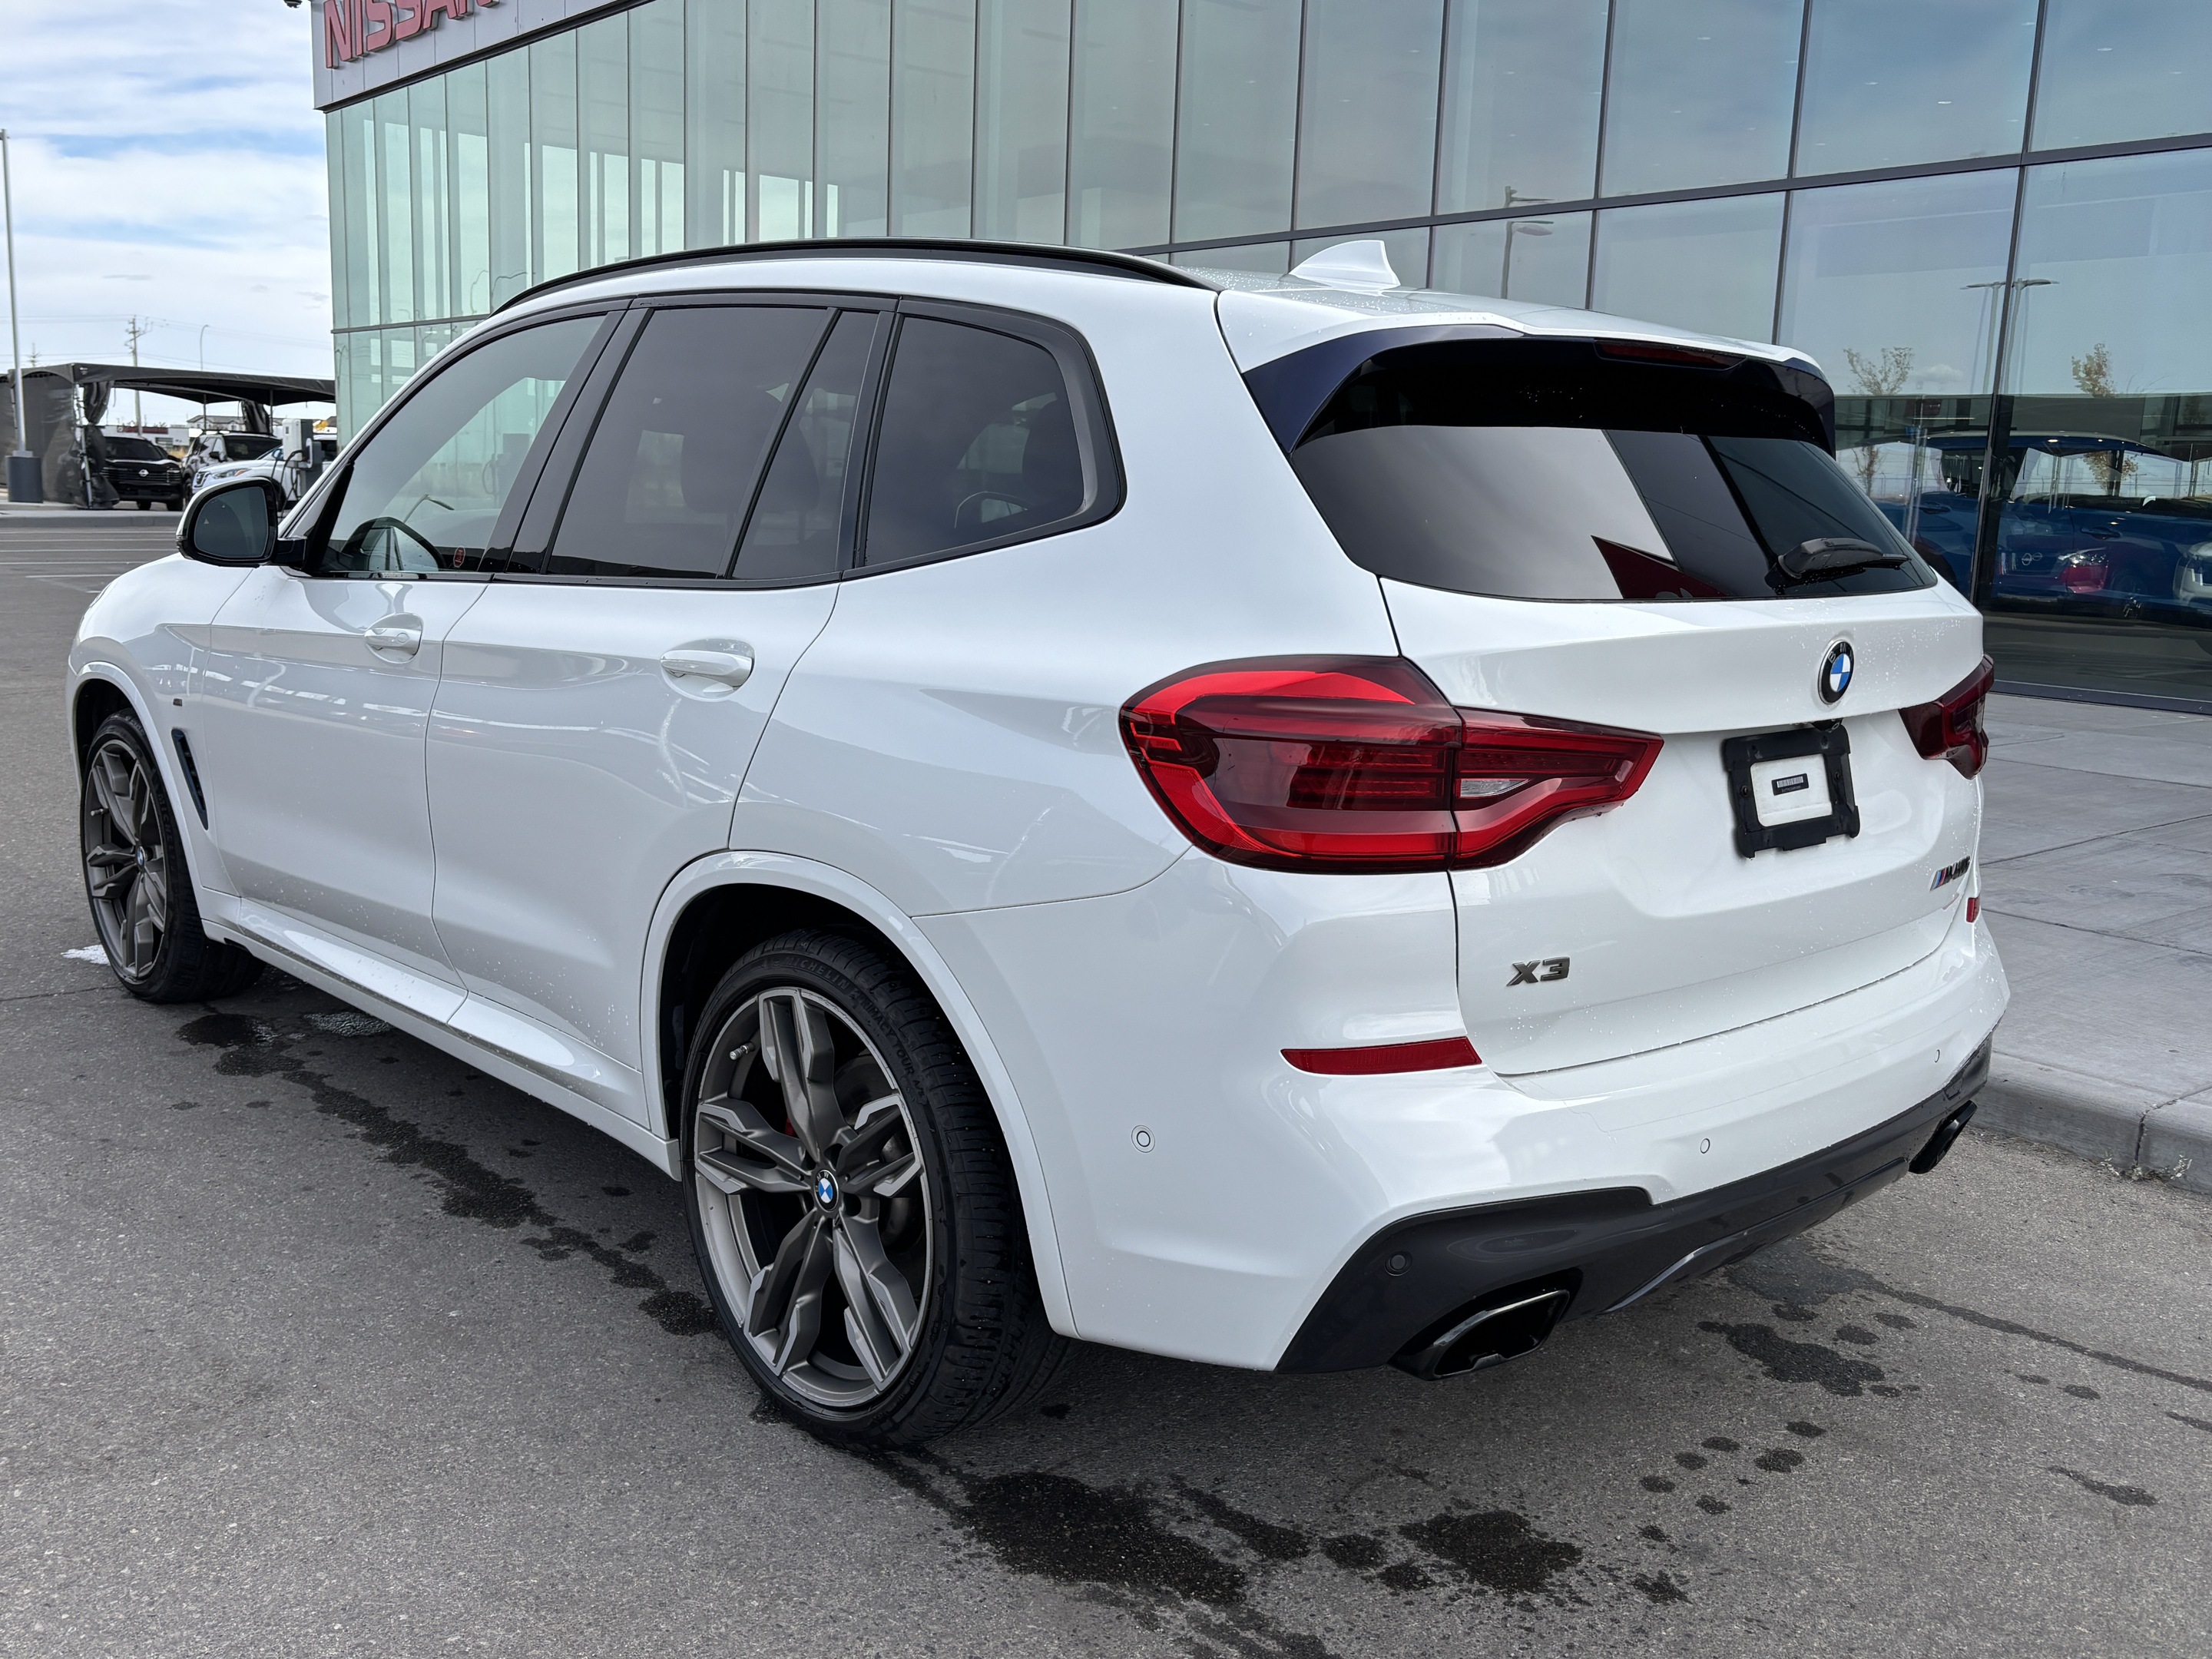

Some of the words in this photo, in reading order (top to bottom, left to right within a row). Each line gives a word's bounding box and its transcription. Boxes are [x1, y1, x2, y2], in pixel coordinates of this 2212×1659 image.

[1506, 956, 1570, 986] X3
[786, 956, 849, 990] MICHELIN
[892, 1040, 915, 1075] TOUR
